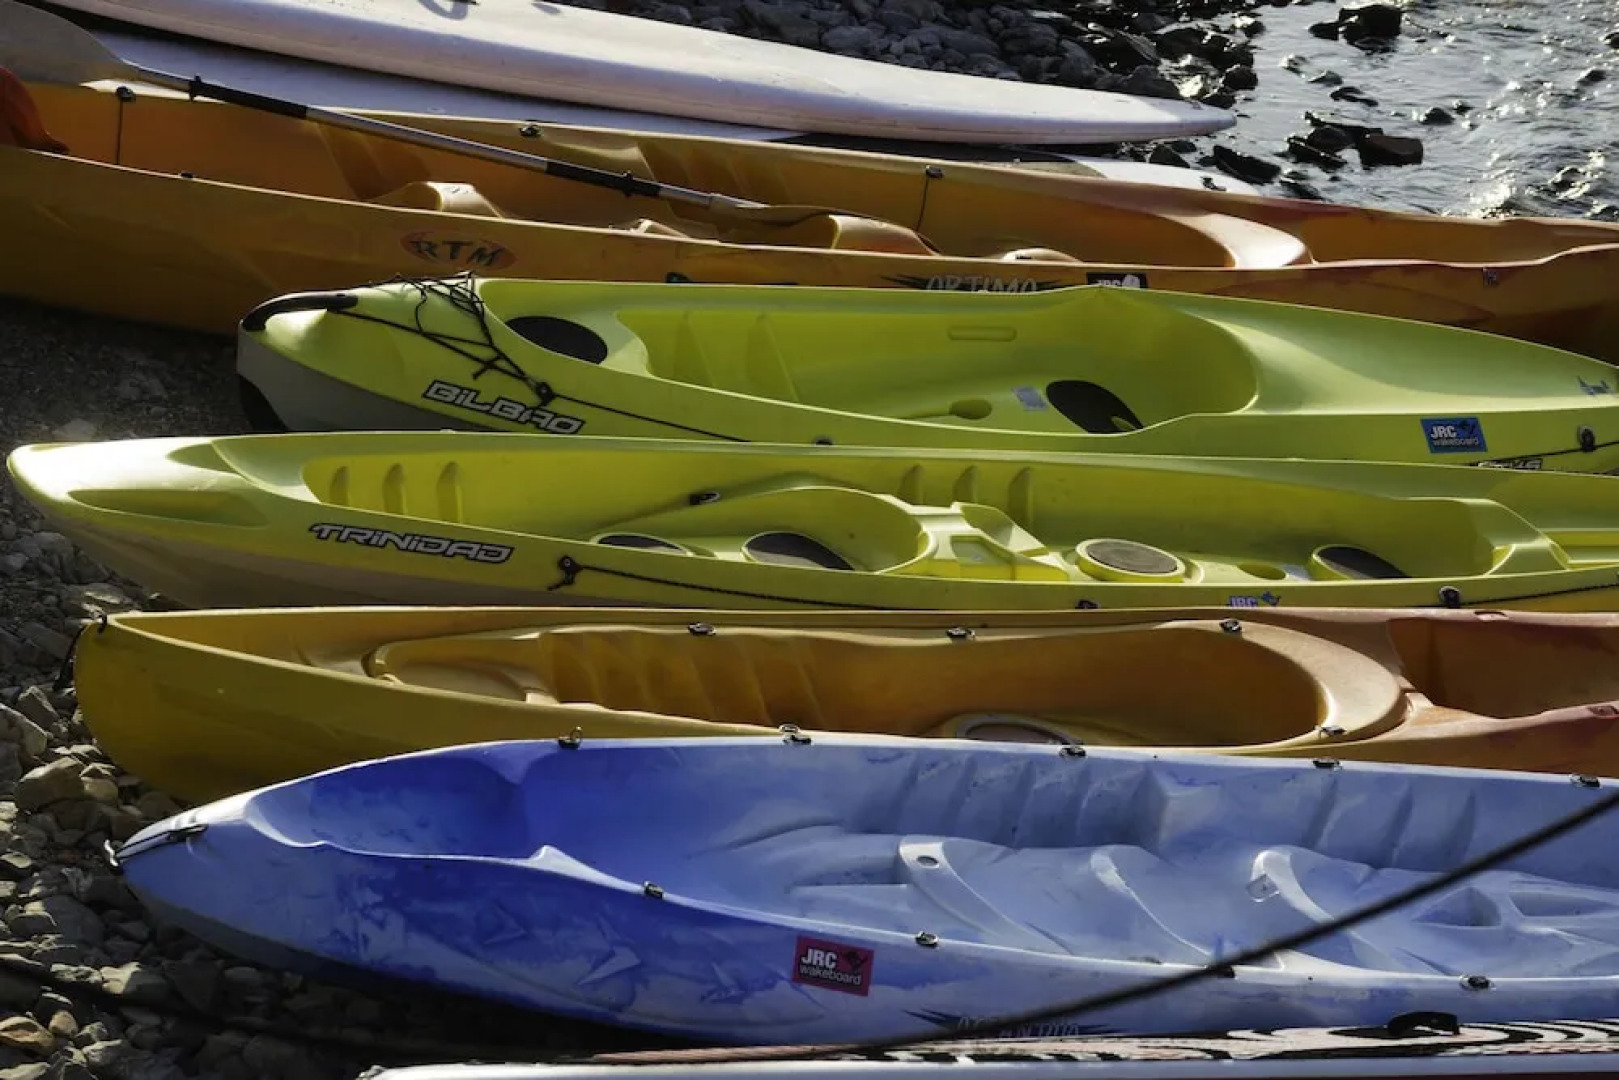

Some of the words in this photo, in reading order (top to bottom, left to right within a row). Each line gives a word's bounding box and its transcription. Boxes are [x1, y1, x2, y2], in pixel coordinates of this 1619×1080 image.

[408, 240, 506, 266] RTM
[1430, 425, 1458, 438] JRC
[801, 948, 838, 969] JRC
[799, 964, 862, 985] wakeboard
